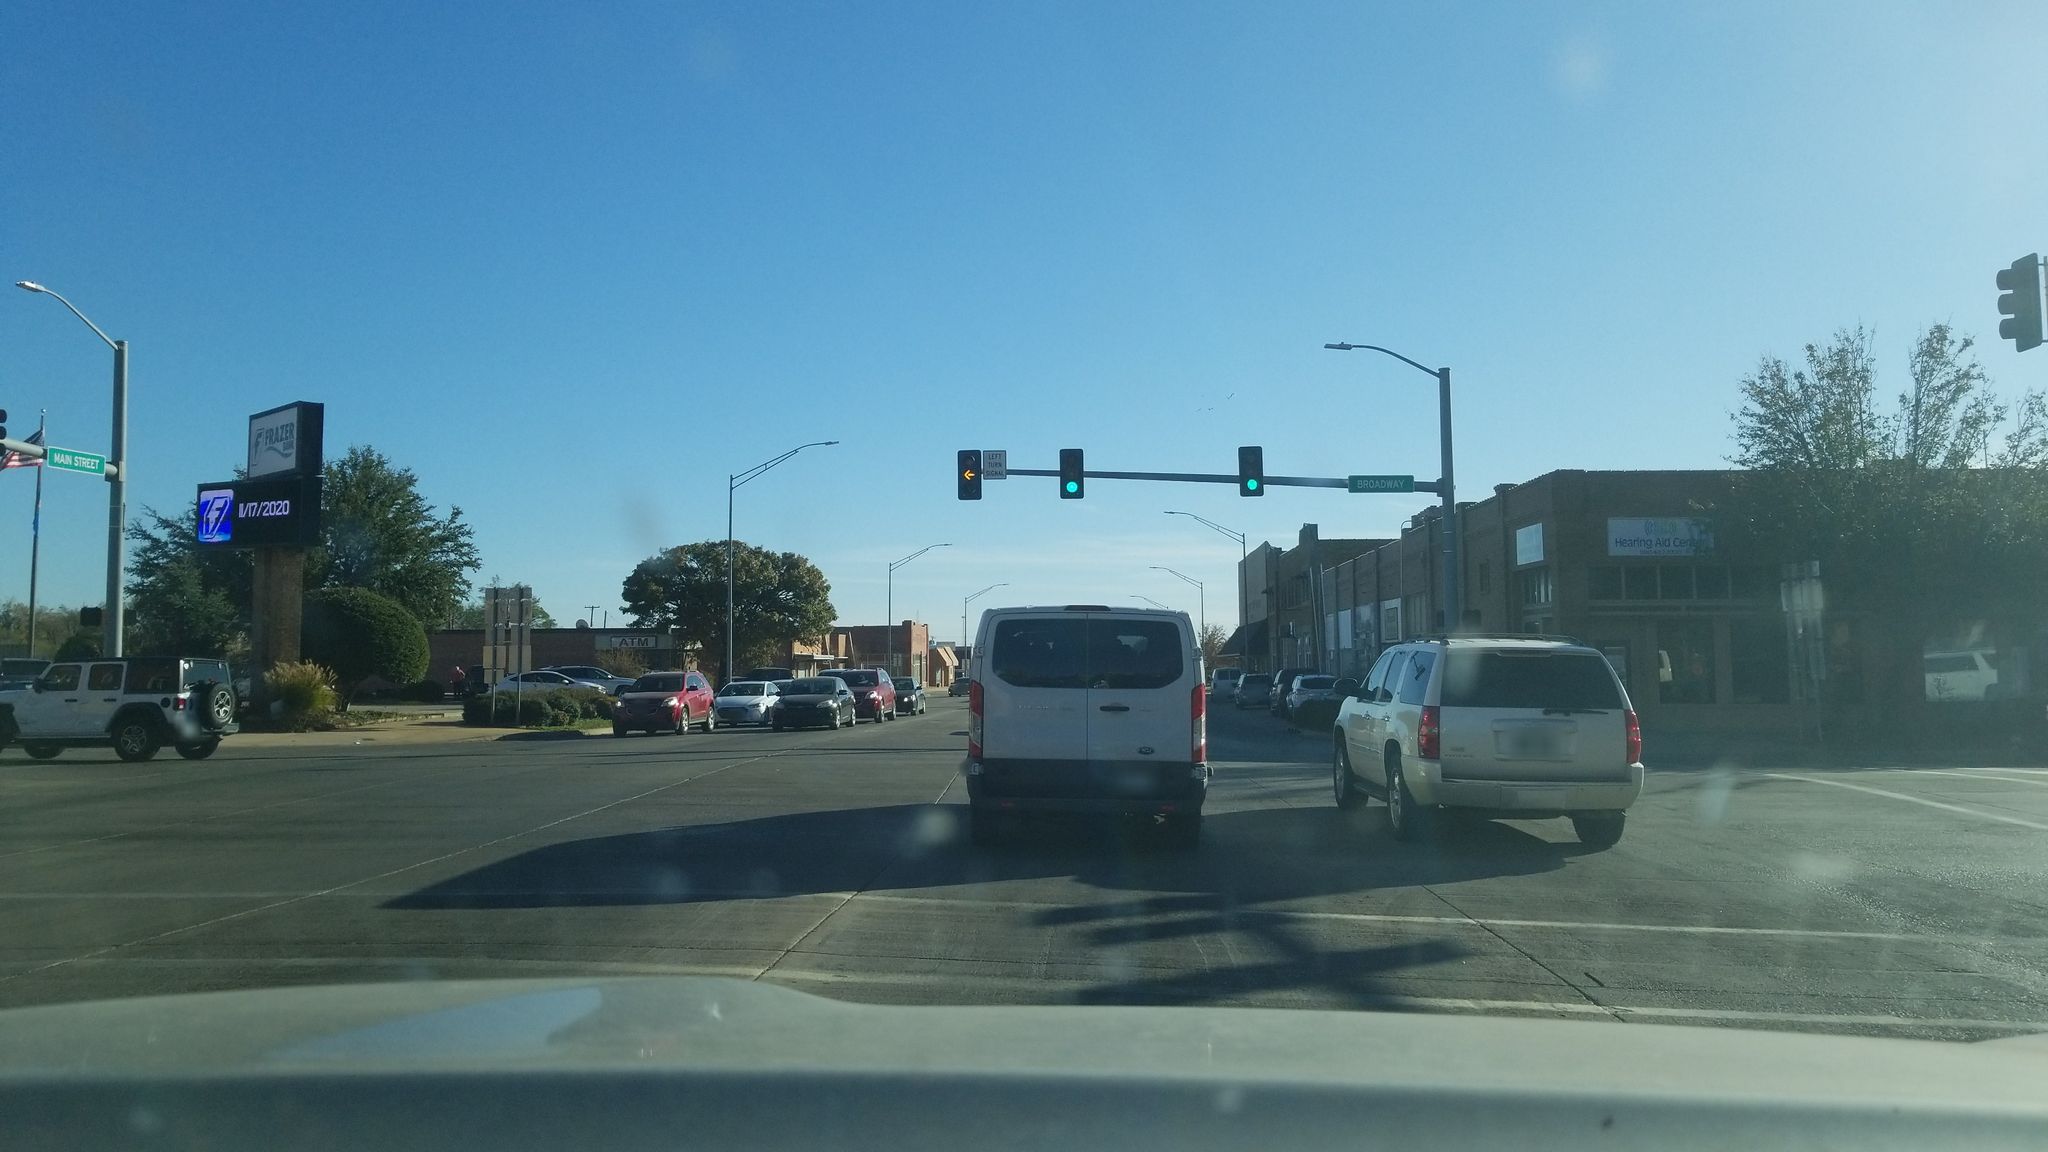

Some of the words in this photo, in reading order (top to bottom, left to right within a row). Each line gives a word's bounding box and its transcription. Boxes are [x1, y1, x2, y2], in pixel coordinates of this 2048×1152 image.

[265, 422, 295, 447] FRAZER
[54, 452, 73, 466] MAIN
[74, 456, 100, 470] STREET
[988, 461, 1002, 469] TURN
[985, 470, 1005, 478] SIGNAL
[1357, 479, 1405, 489] BROADWAY
[238, 499, 290, 518] 11/17/2020
[1615, 537, 1653, 549] Hearing
[1655, 537, 1671, 548] Aid
[619, 637, 649, 647] ATM
